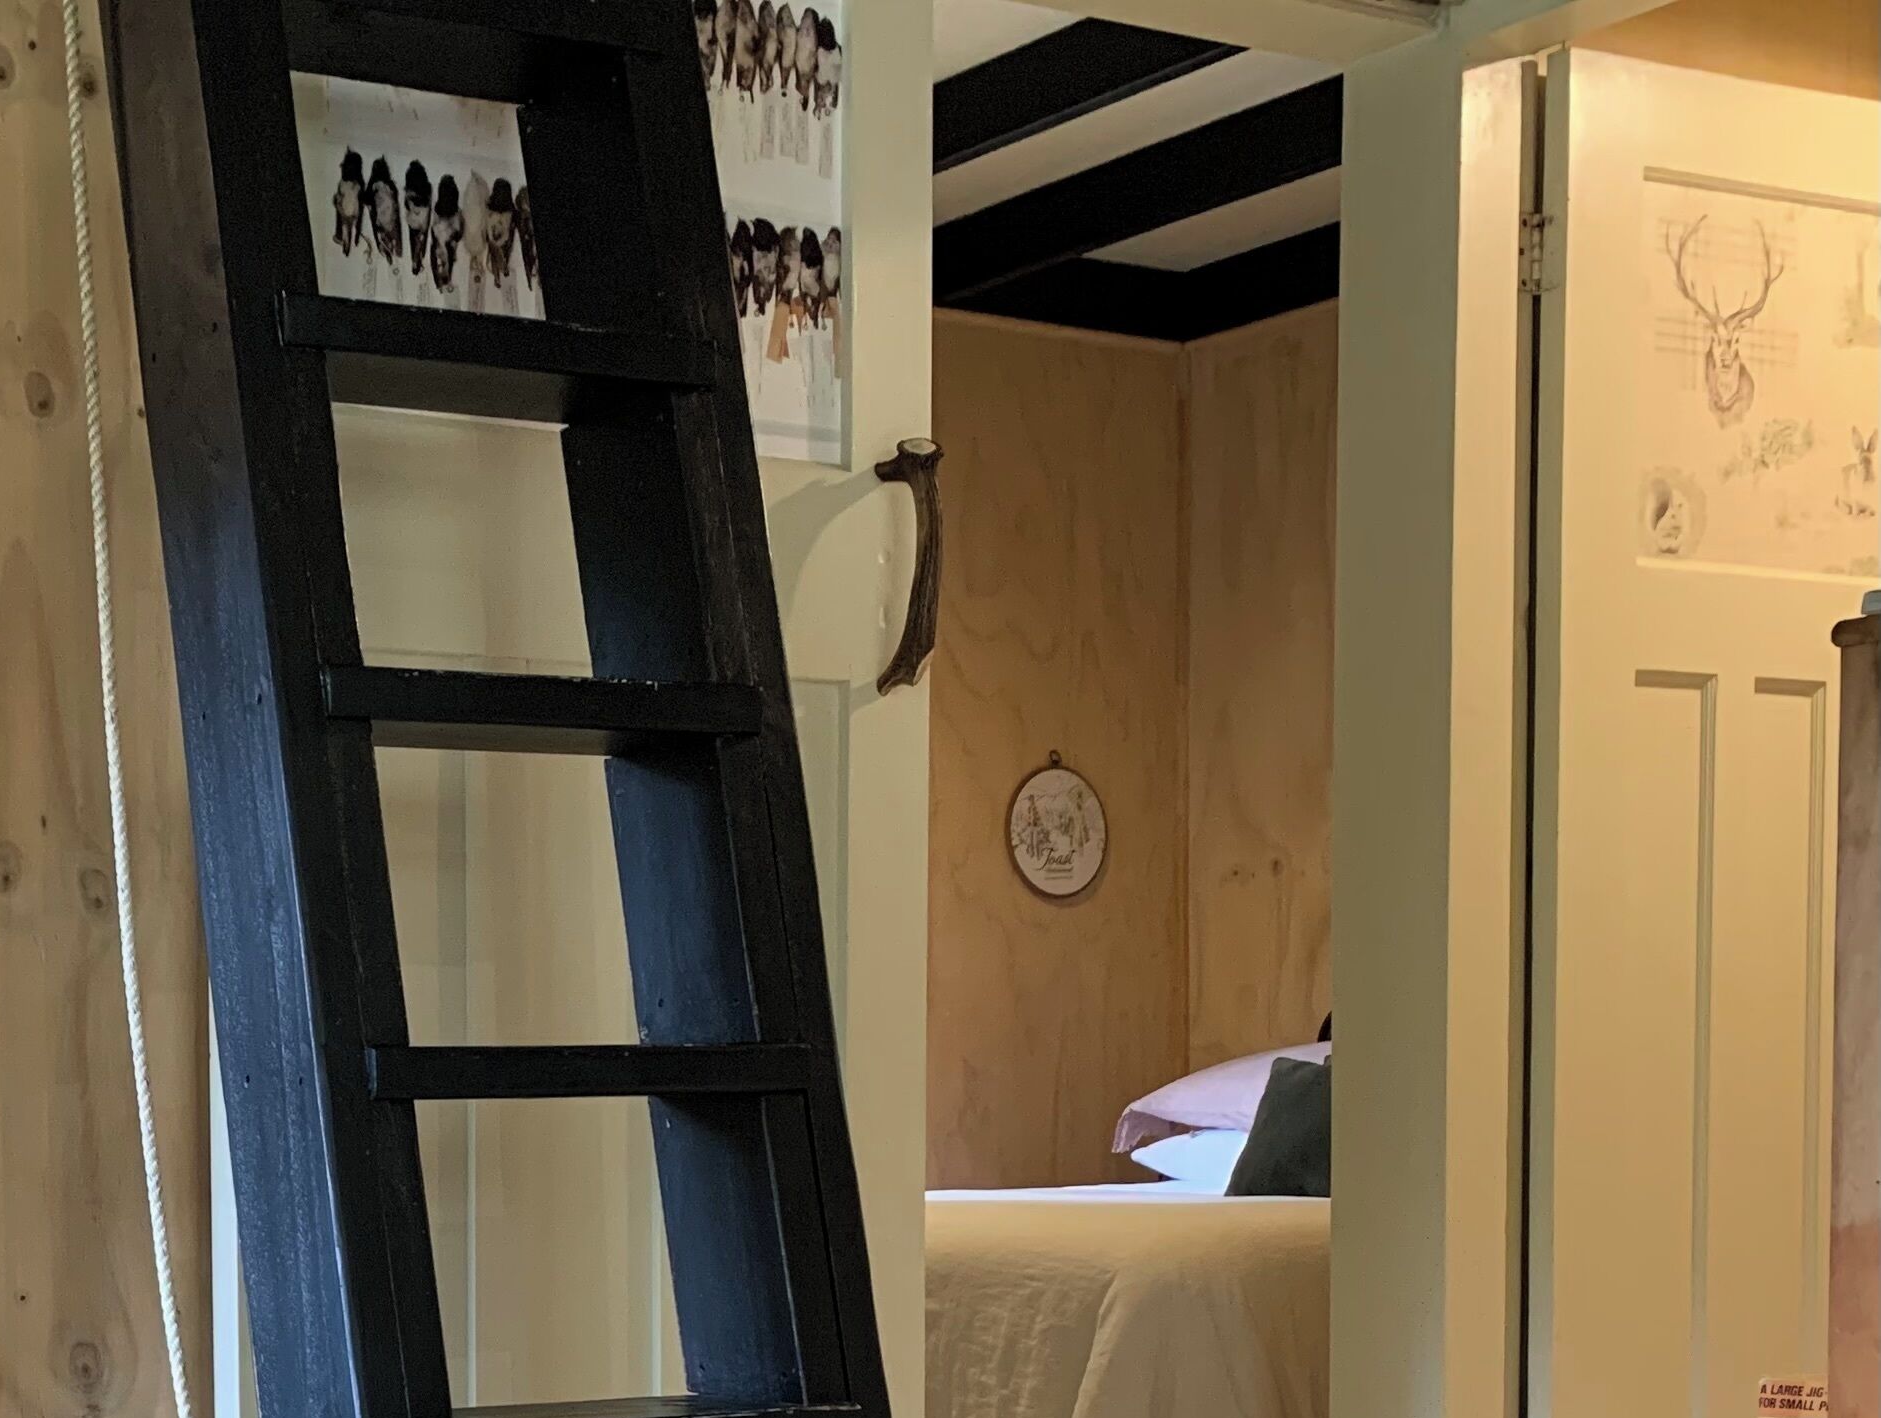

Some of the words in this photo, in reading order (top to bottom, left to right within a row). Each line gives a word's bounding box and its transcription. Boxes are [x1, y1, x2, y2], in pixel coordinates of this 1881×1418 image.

[1760, 1384, 1767, 1394] A
[1771, 1384, 1804, 1397] LARGE
[1759, 1397, 1776, 1408] FOR
[1779, 1398, 1814, 1411] SMALL
